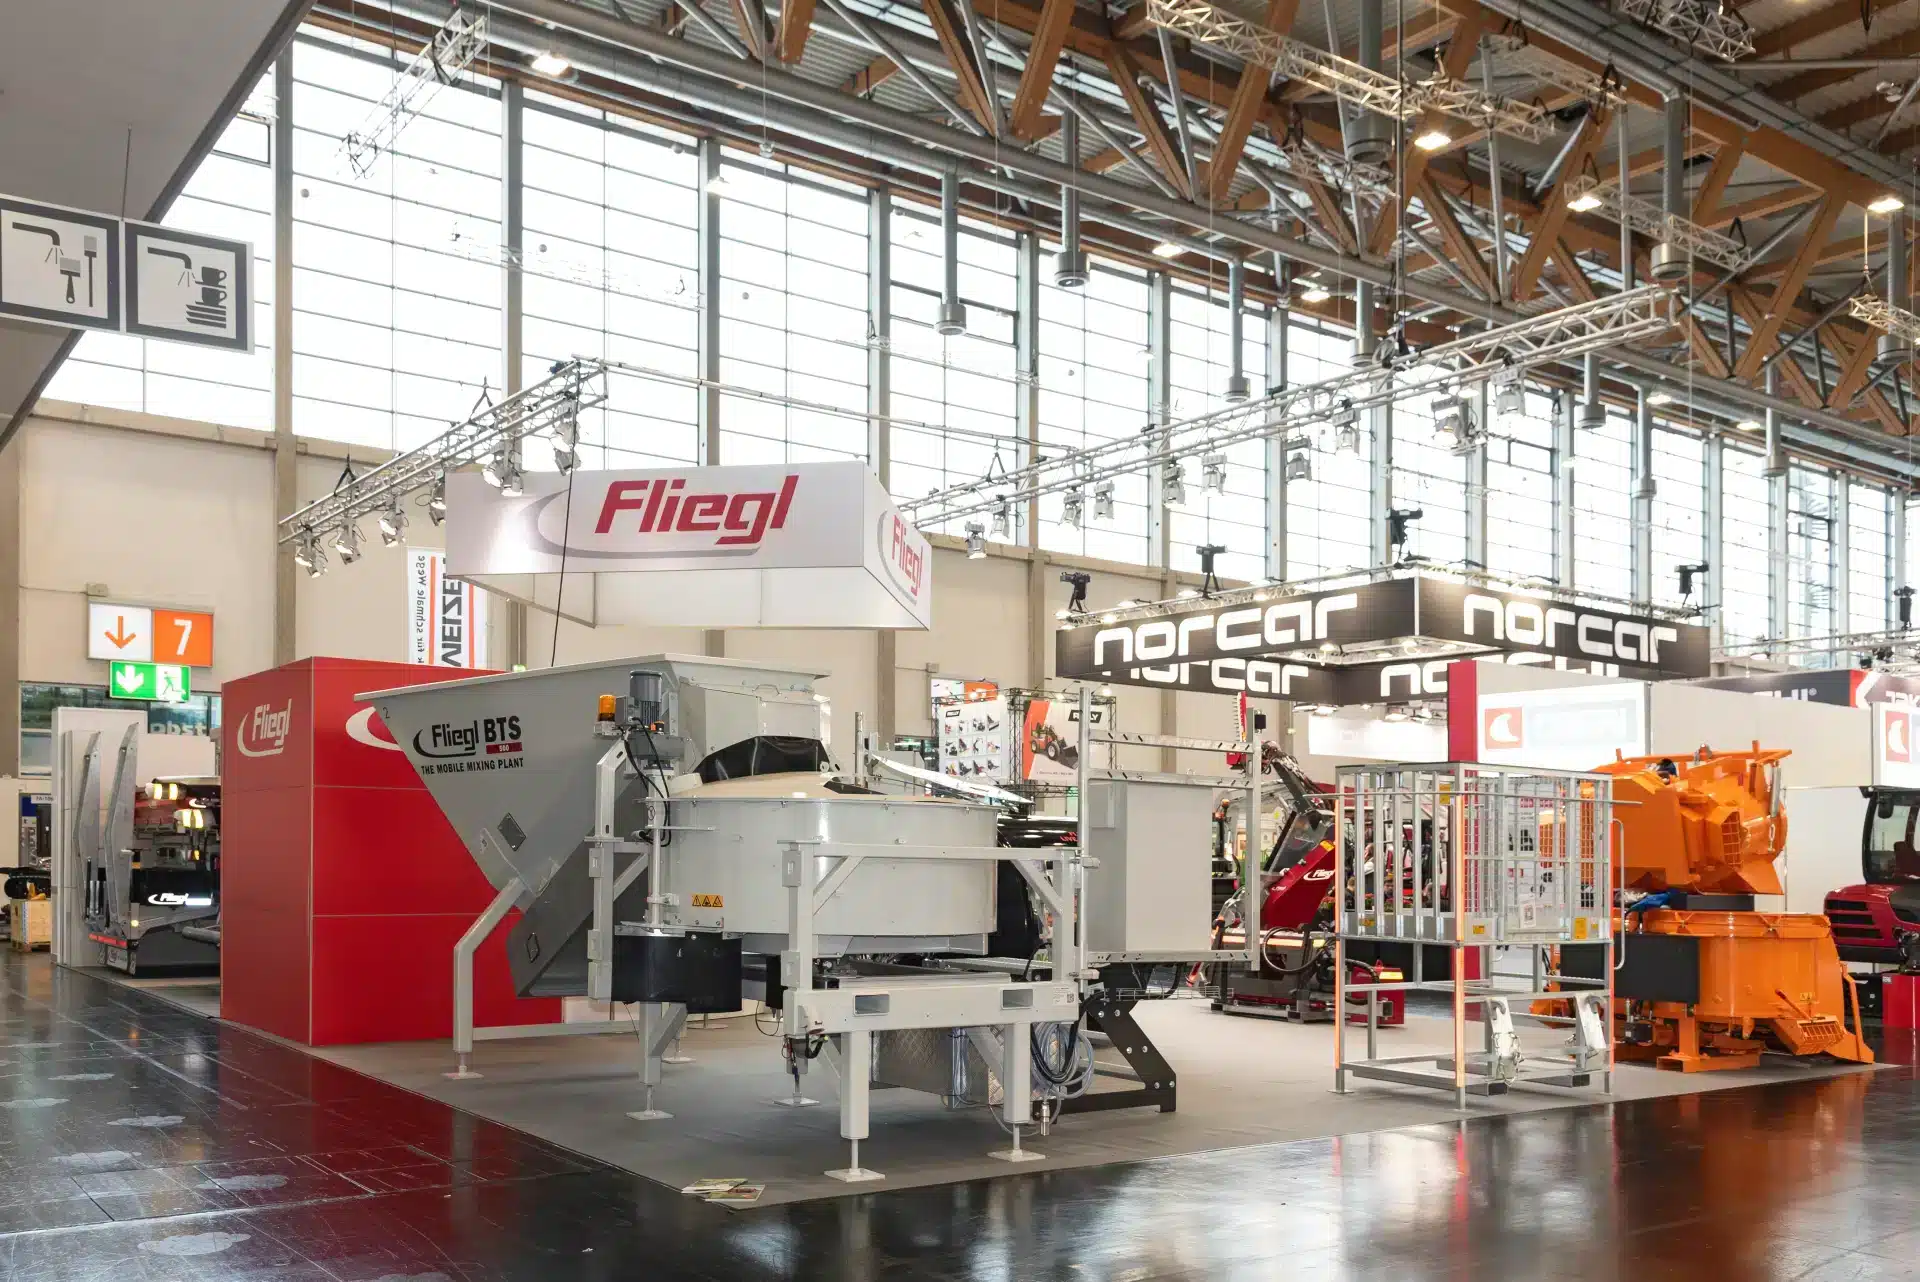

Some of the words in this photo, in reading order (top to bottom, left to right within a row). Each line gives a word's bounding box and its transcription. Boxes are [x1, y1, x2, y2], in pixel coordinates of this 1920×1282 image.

[594, 475, 799, 546] Fliegl
[892, 514, 924, 596] Fliegl
[174, 618, 193, 656] 7
[1094, 593, 1358, 666] norcar
[1463, 593, 1677, 664] norcar
[252, 698, 292, 747] Fliegl
[431, 720, 480, 751] Fliegl
[483, 715, 522, 743] BTS
[421, 765, 435, 775] THE
[436, 762, 465, 774] MOBILE
[467, 760, 496, 772] MIXING
[498, 757, 524, 770] PLANT
